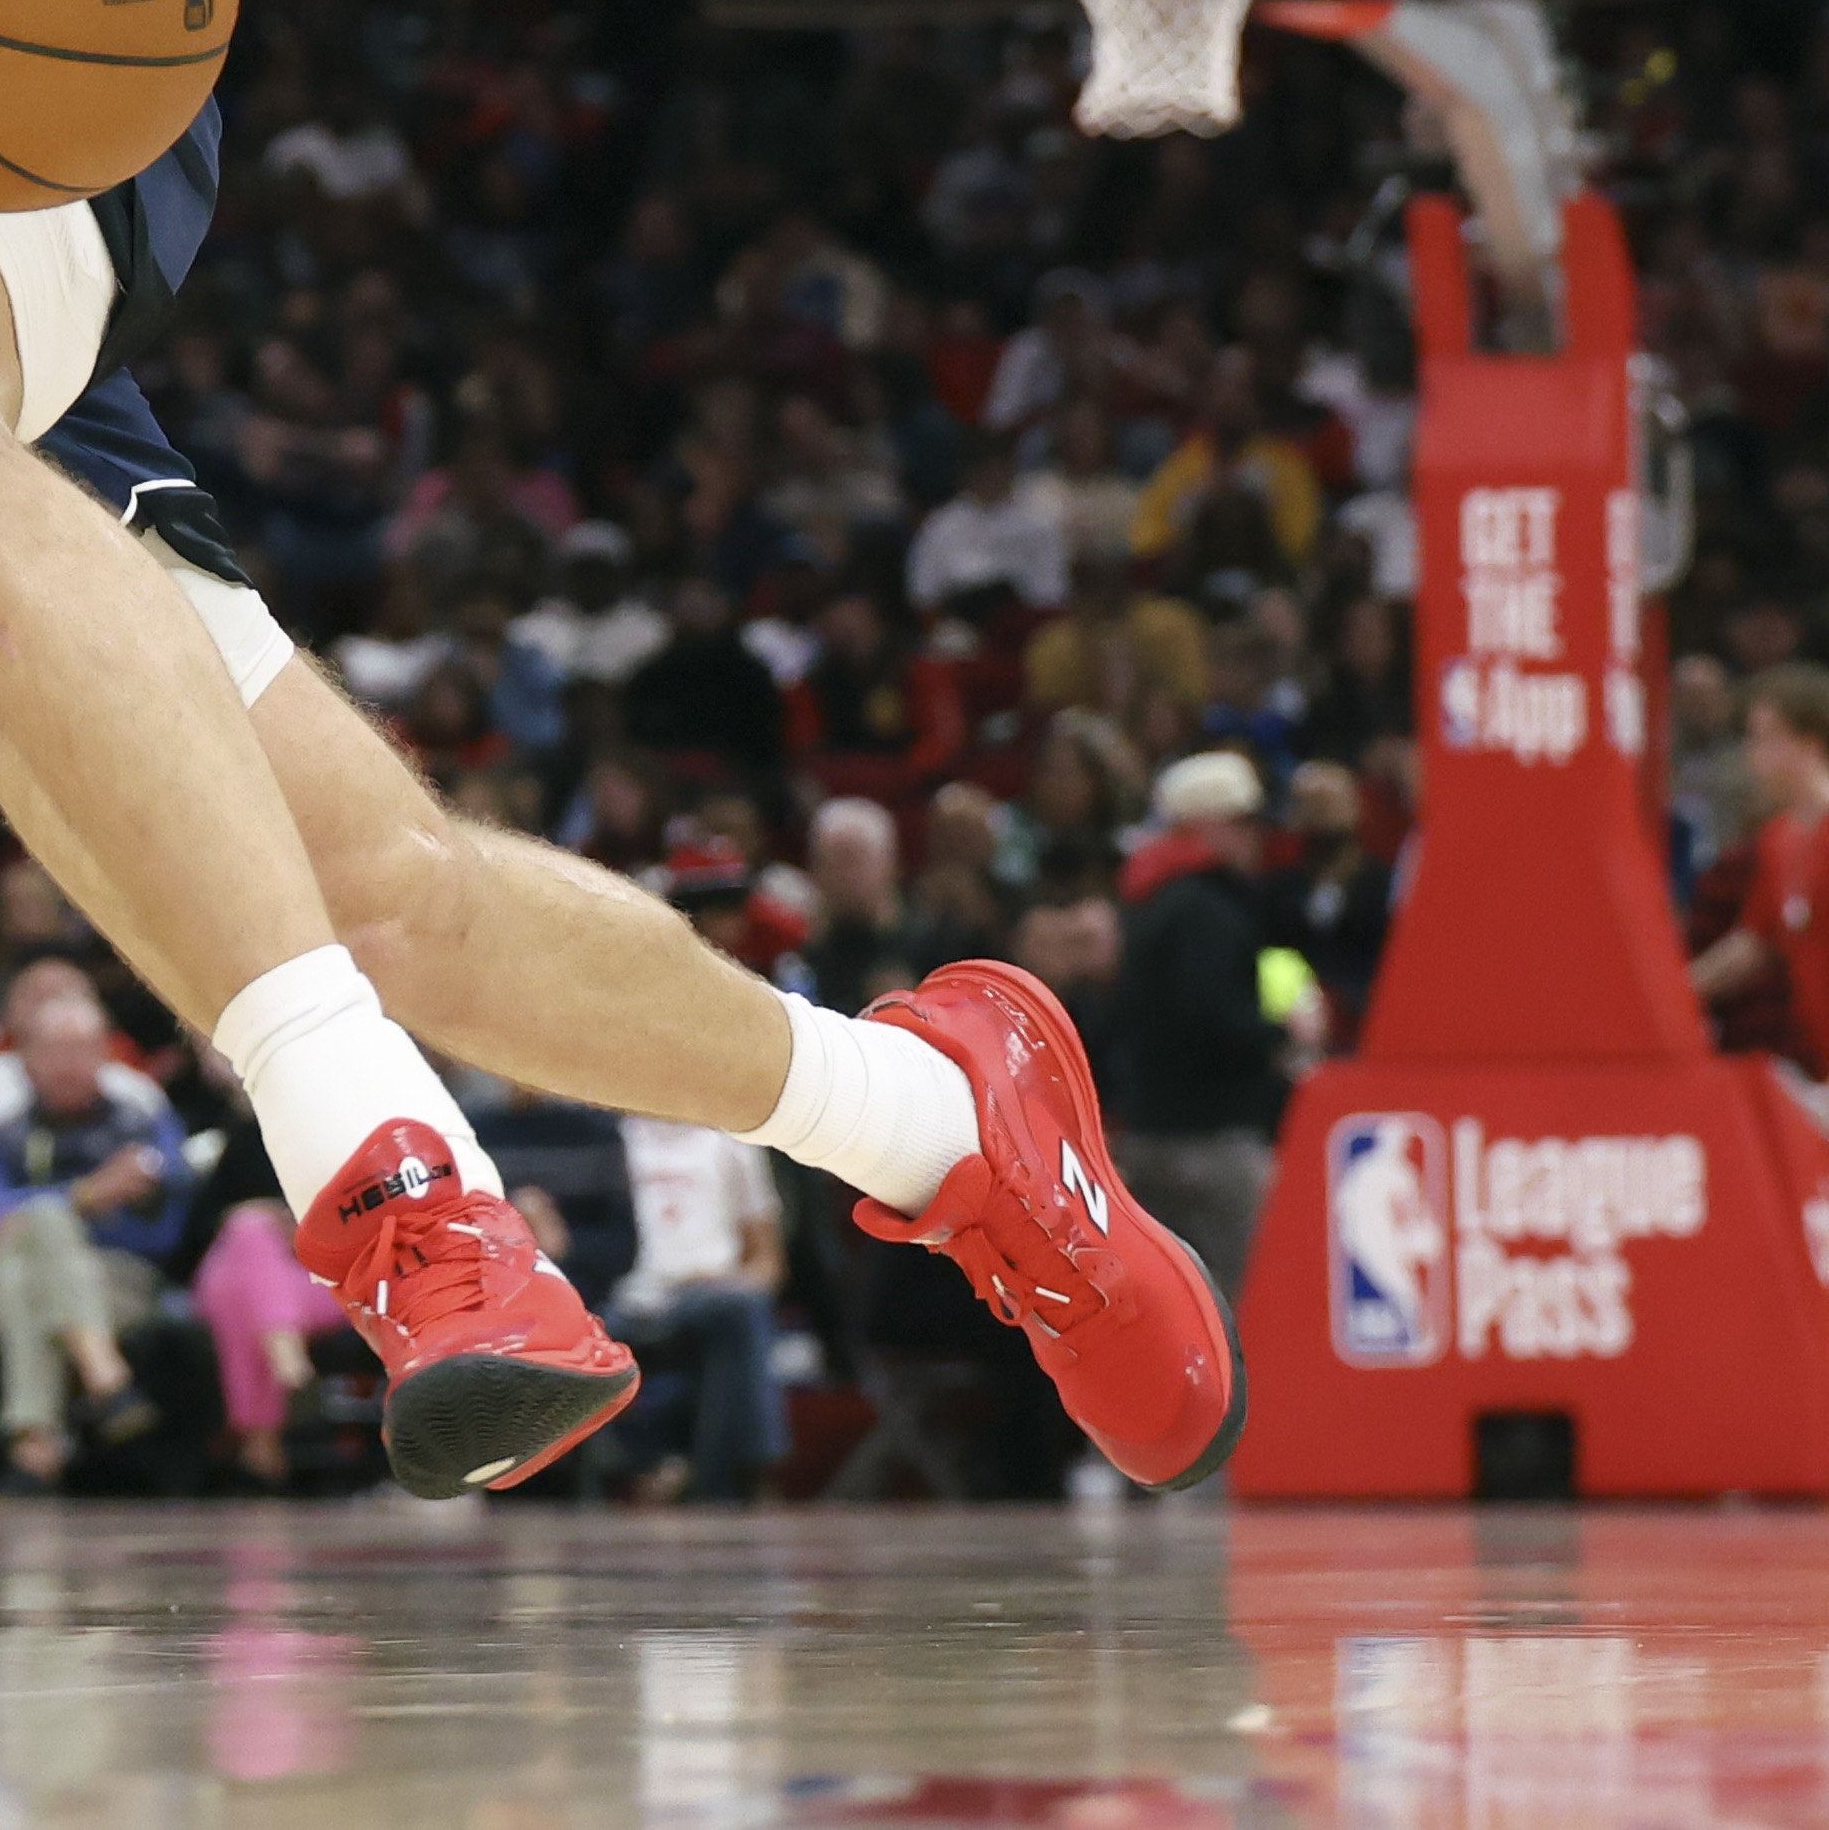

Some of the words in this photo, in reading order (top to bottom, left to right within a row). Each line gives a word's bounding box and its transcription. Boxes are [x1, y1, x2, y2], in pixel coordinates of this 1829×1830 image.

[1459, 485, 1564, 568] GET
[1458, 570, 1566, 660] THE
[1482, 658, 1589, 768] App
[1452, 1116, 1707, 1255] League
[1456, 1236, 1635, 1360] Pass
